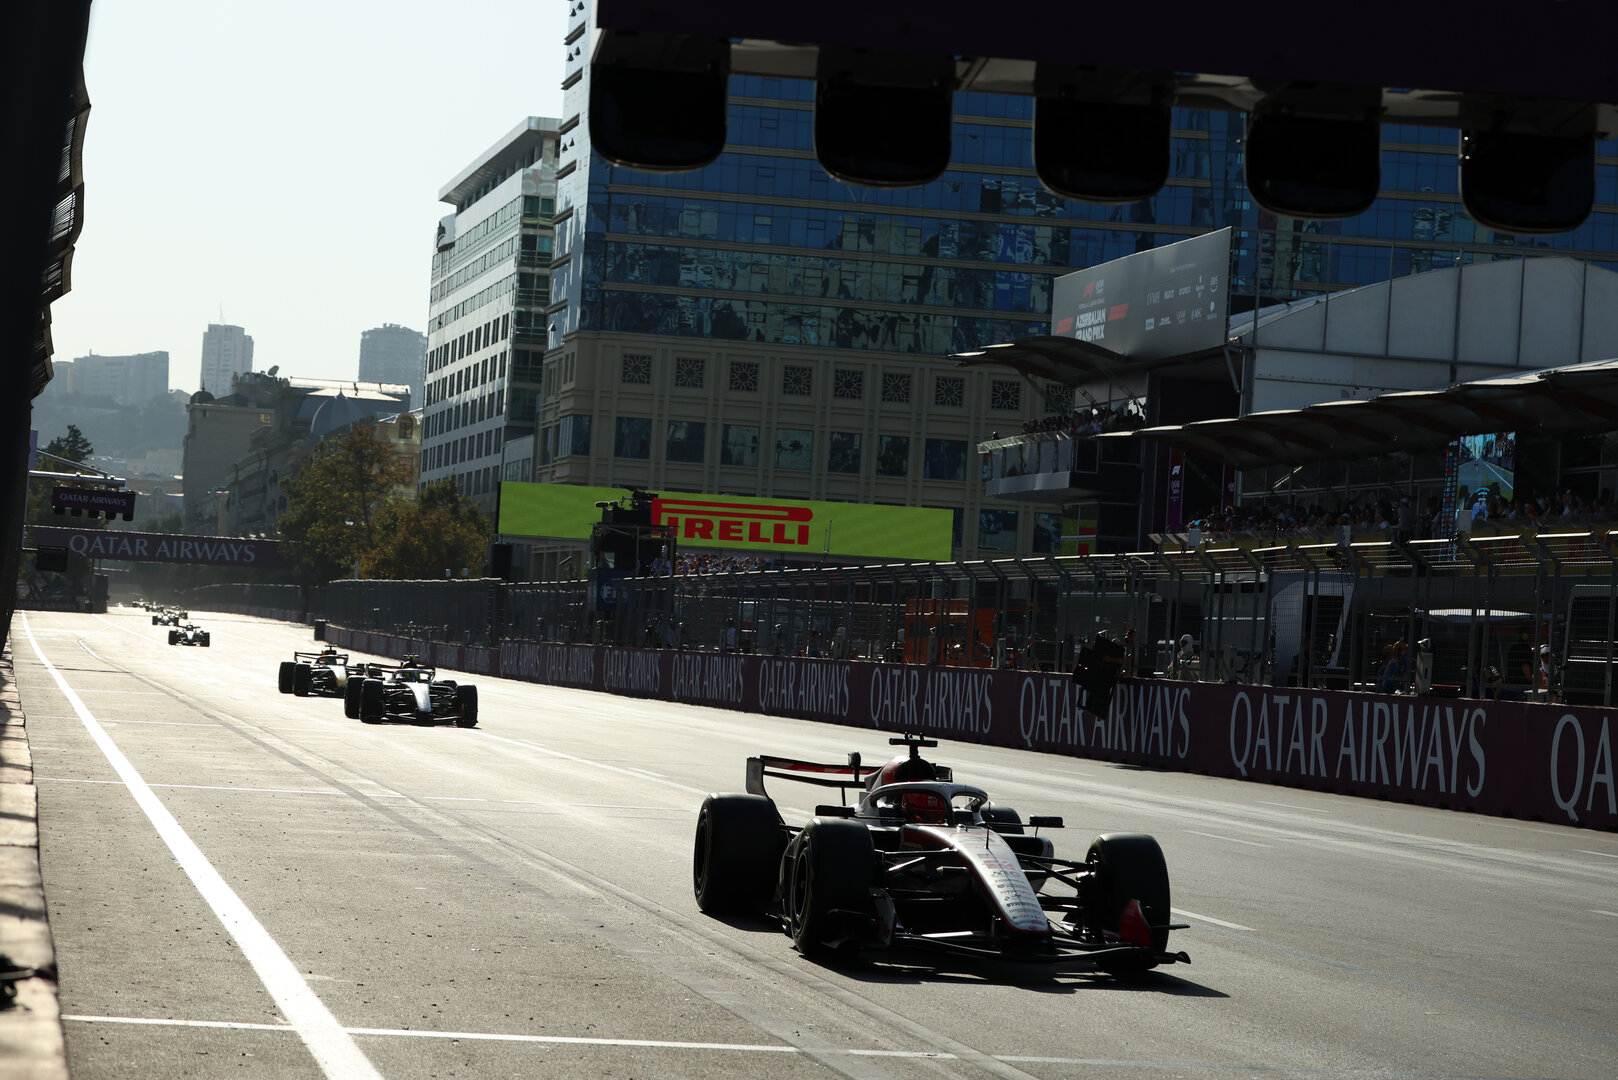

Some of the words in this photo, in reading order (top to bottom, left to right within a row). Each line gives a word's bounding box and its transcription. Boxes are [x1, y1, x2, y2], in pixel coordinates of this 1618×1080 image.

[1076, 308, 1106, 330] AZERBAIJAN
[60, 493, 89, 503] QATAR
[90, 497, 127, 505] AIRWAYS
[651, 498, 813, 545] PIRELLI
[69, 535, 149, 557] QATAR
[155, 540, 256, 562] AIRWAYS
[603, 649, 627, 691] QATAR
[628, 651, 661, 693] AIRWAYS
[671, 654, 700, 701] QATAR
[701, 656, 745, 703] AIRWAYS
[758, 659, 796, 711] QATAR
[797, 663, 850, 717] AIRWAYS
[869, 667, 919, 727] QATAR
[921, 670, 994, 734] AIRWAYS
[1019, 676, 1087, 748] QATAR
[1229, 691, 1328, 777] QATAR
[1335, 699, 1487, 798] AIRWAYS
